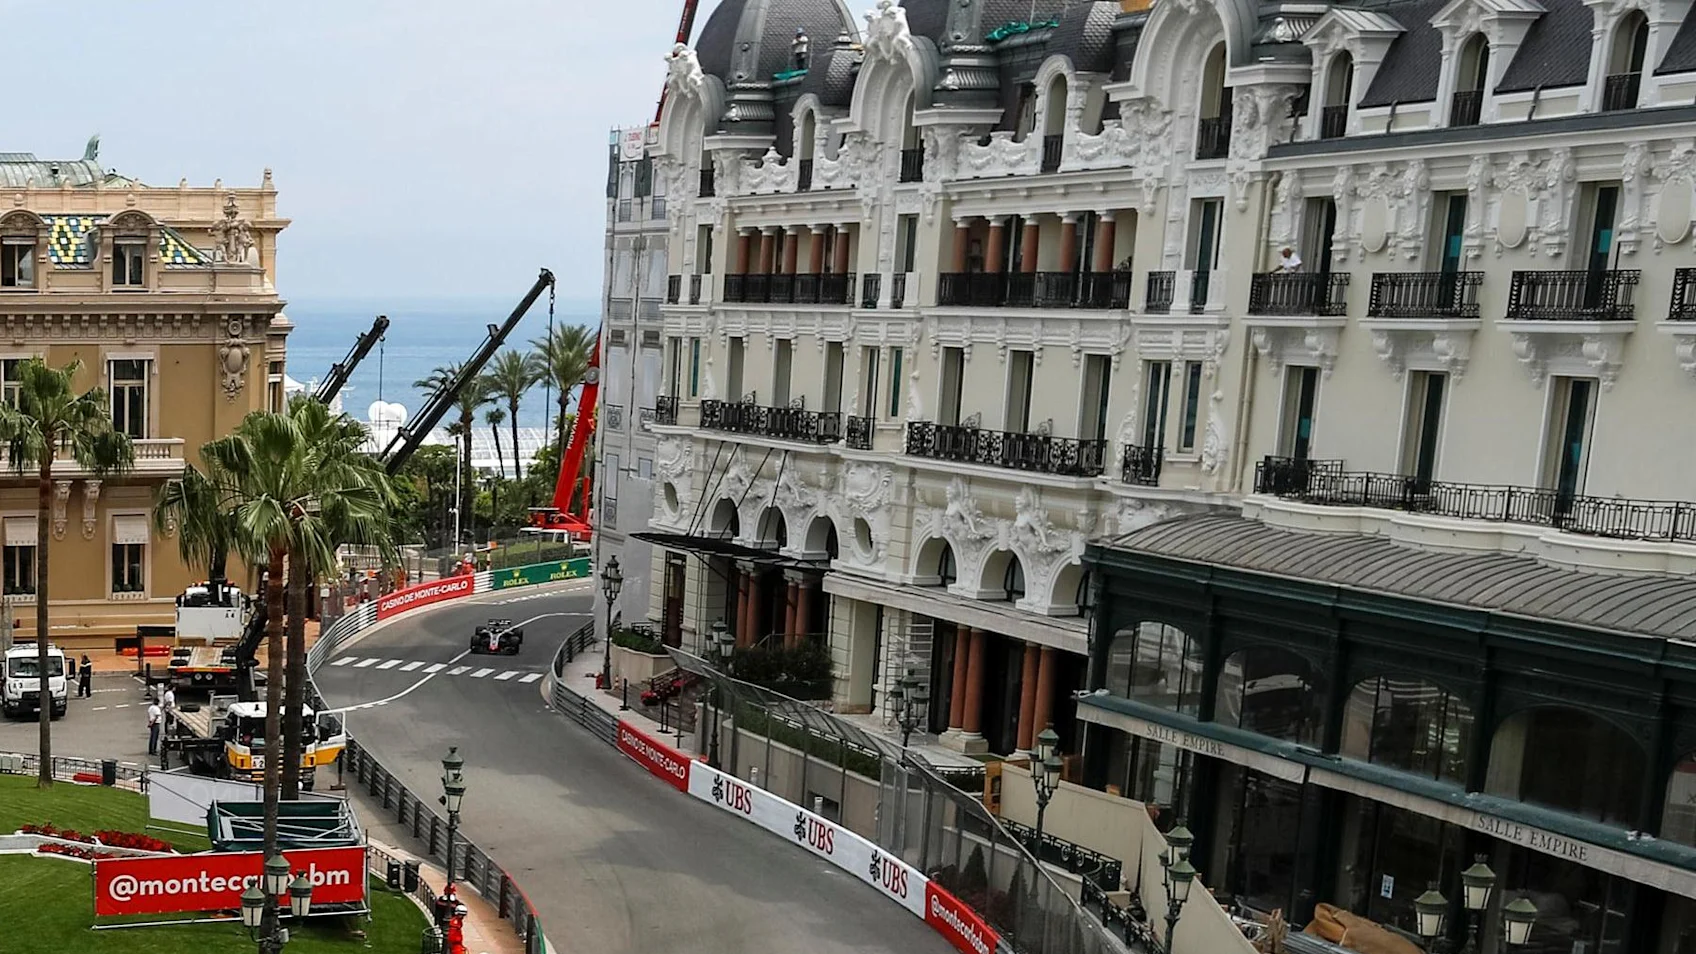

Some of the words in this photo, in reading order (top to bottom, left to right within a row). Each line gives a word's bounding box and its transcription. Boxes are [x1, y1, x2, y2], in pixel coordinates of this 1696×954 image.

[503, 577, 529, 587] ROLEX
[550, 570, 578, 580] ROLEX
[381, 596, 404, 611] CASINO
[404, 592, 414, 603] DE
[414, 580, 468, 600] MONTE-CARLO
[1147, 725, 1177, 743] SALLE
[1183, 734, 1224, 756] EMPIRE
[645, 744, 686, 779] MONTE-CARLO
[726, 780, 753, 815] UBS
[808, 818, 835, 855] UBS
[1478, 815, 1522, 841] SALLE
[1530, 831, 1589, 862] EMPIRE
[109, 863, 350, 902] @montecabm
[882, 858, 909, 899] UBS
